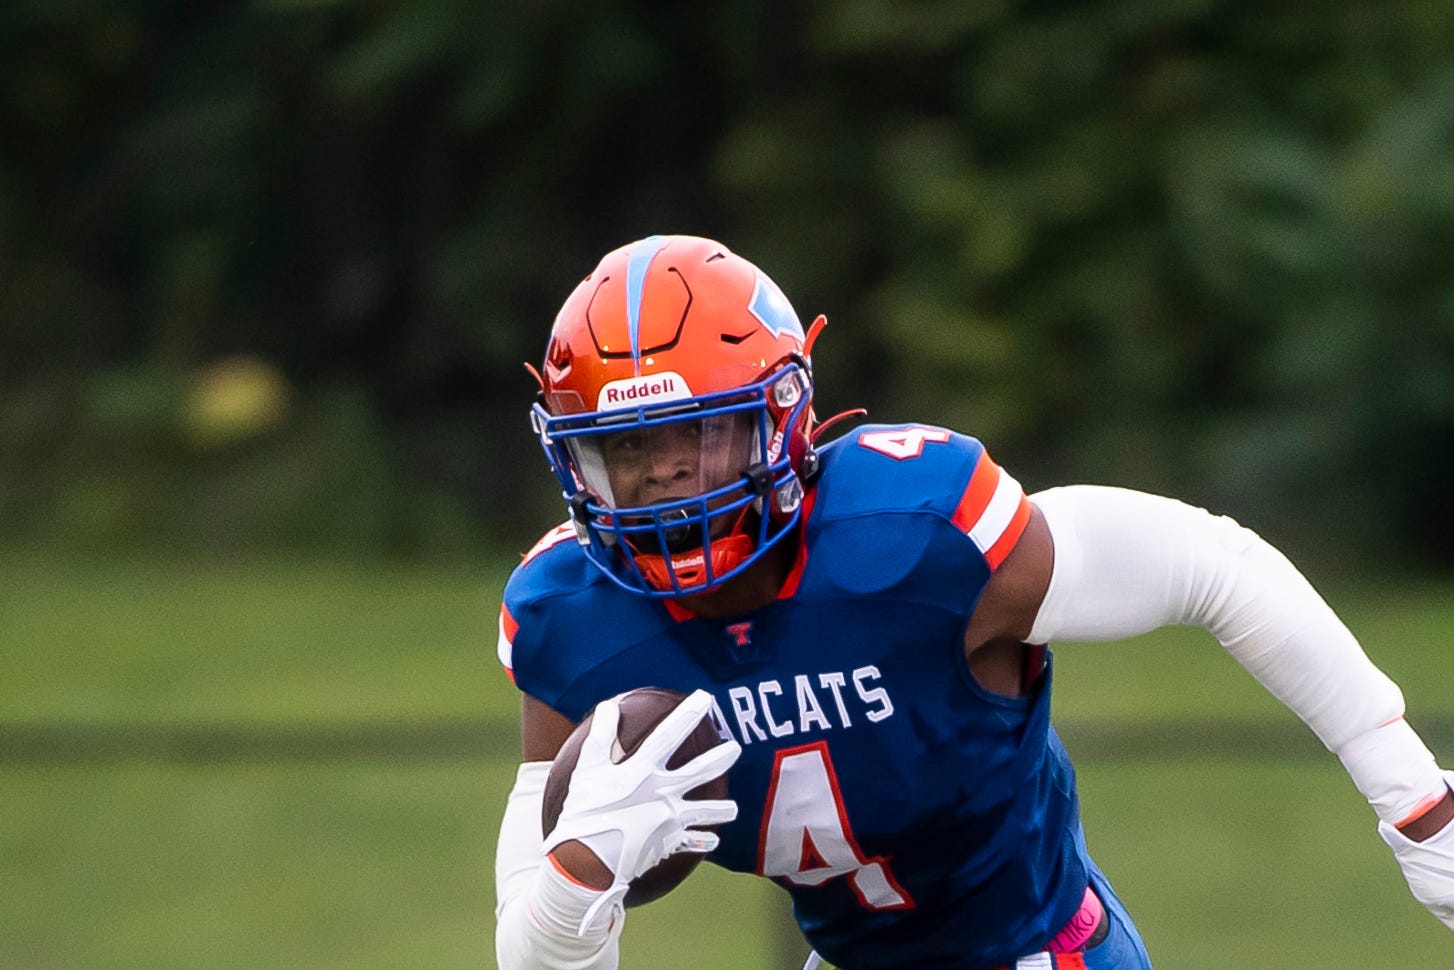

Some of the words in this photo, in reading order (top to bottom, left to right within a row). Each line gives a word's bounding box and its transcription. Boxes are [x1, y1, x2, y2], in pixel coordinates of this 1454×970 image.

[607, 378, 674, 403] Riddell
[858, 427, 951, 461] 4
[710, 665, 894, 744] ARCATS
[757, 739, 916, 911] 4
